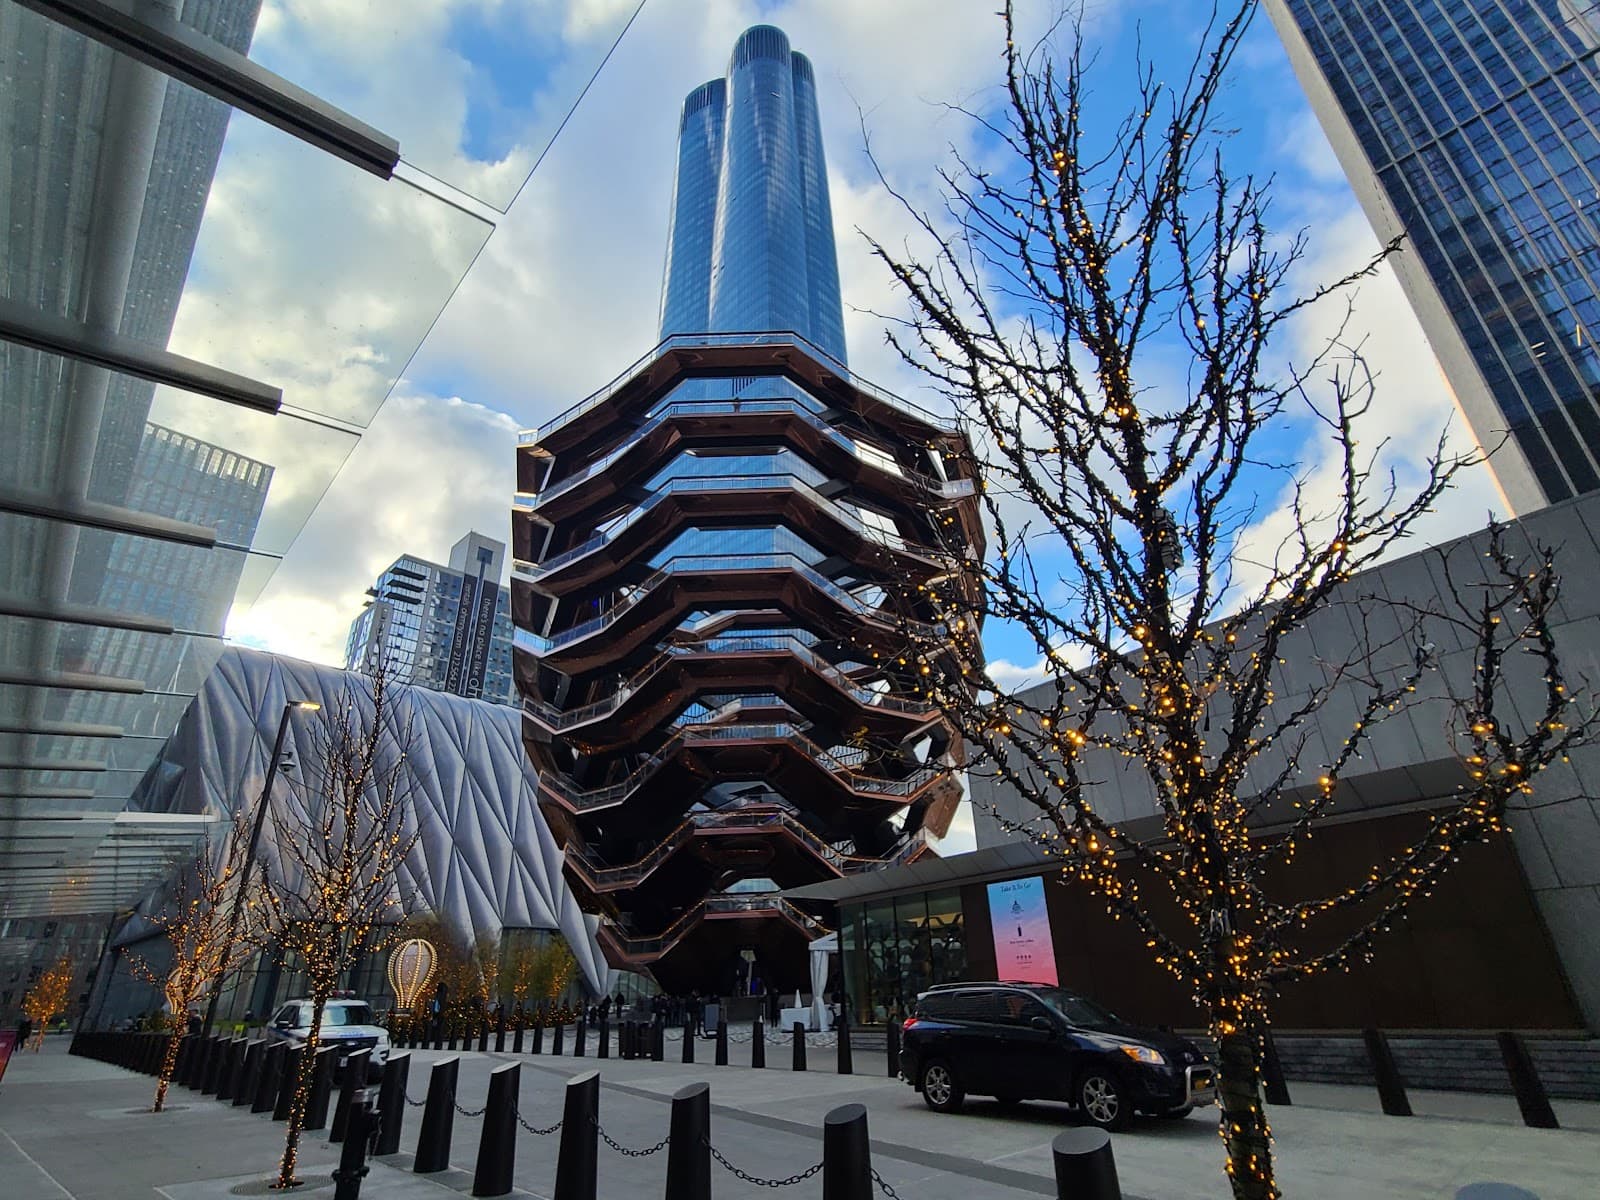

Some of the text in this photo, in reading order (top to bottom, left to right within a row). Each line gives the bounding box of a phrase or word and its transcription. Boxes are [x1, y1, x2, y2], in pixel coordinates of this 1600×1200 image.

[482, 598, 491, 622] there's
[479, 624, 487, 636] no
[475, 637, 485, 659] place
[473, 661, 482, 675] like
